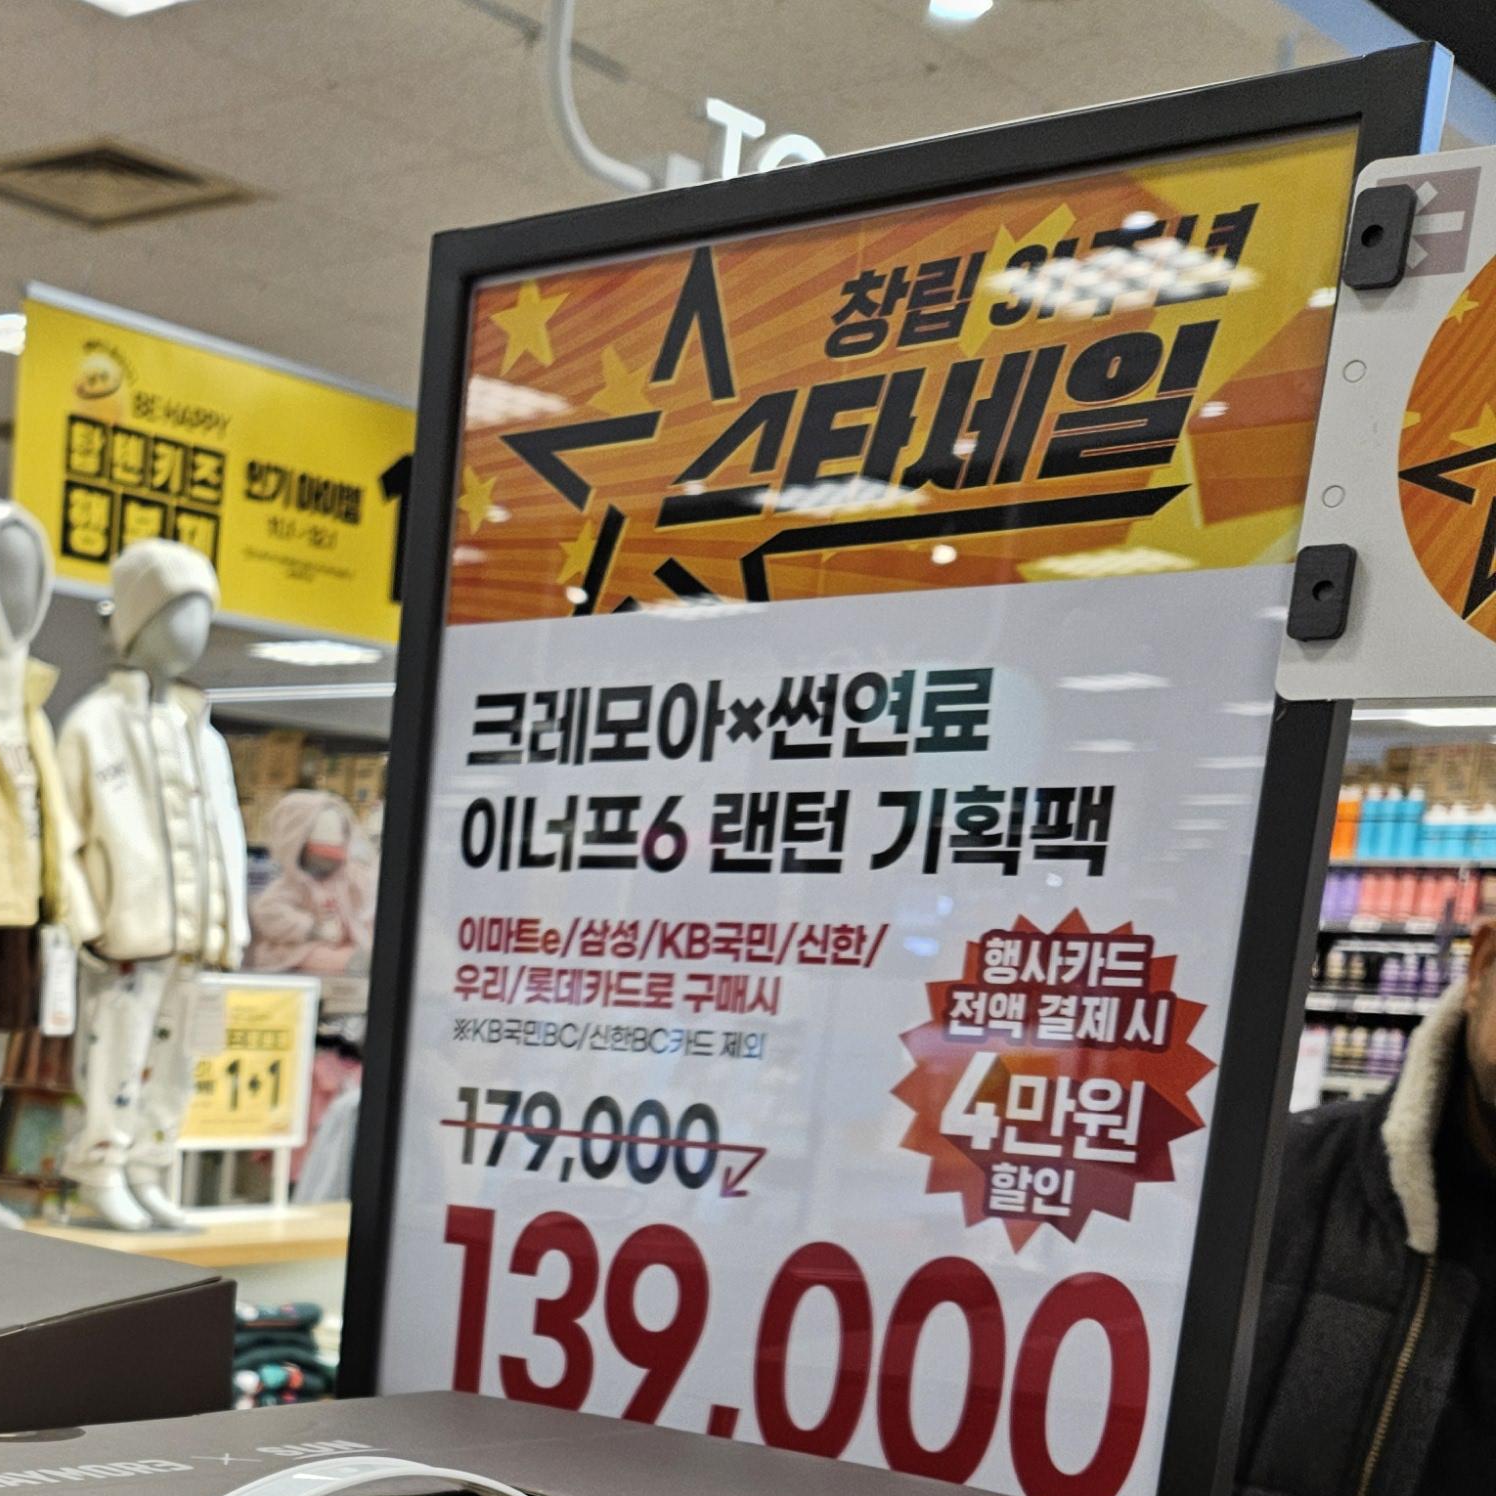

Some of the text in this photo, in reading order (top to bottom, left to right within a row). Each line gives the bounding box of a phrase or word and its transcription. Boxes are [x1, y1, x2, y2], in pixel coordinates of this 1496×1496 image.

[825, 251, 986, 359] 창립
[657, 320, 1221, 528] 스타세일
[459, 784, 1115, 877] 이너프6 랜턴 기획팩
[453, 964, 782, 1015] 우리/롯데카드로 구매시
[983, 938, 1146, 988] 행사카드
[718, 1030, 767, 1060] 제외
[949, 991, 1027, 1040] 전액
[457, 1087, 721, 1190] 179,000
[939, 1052, 1146, 1164] 4만원
[989, 1163, 1075, 1217] 할인
